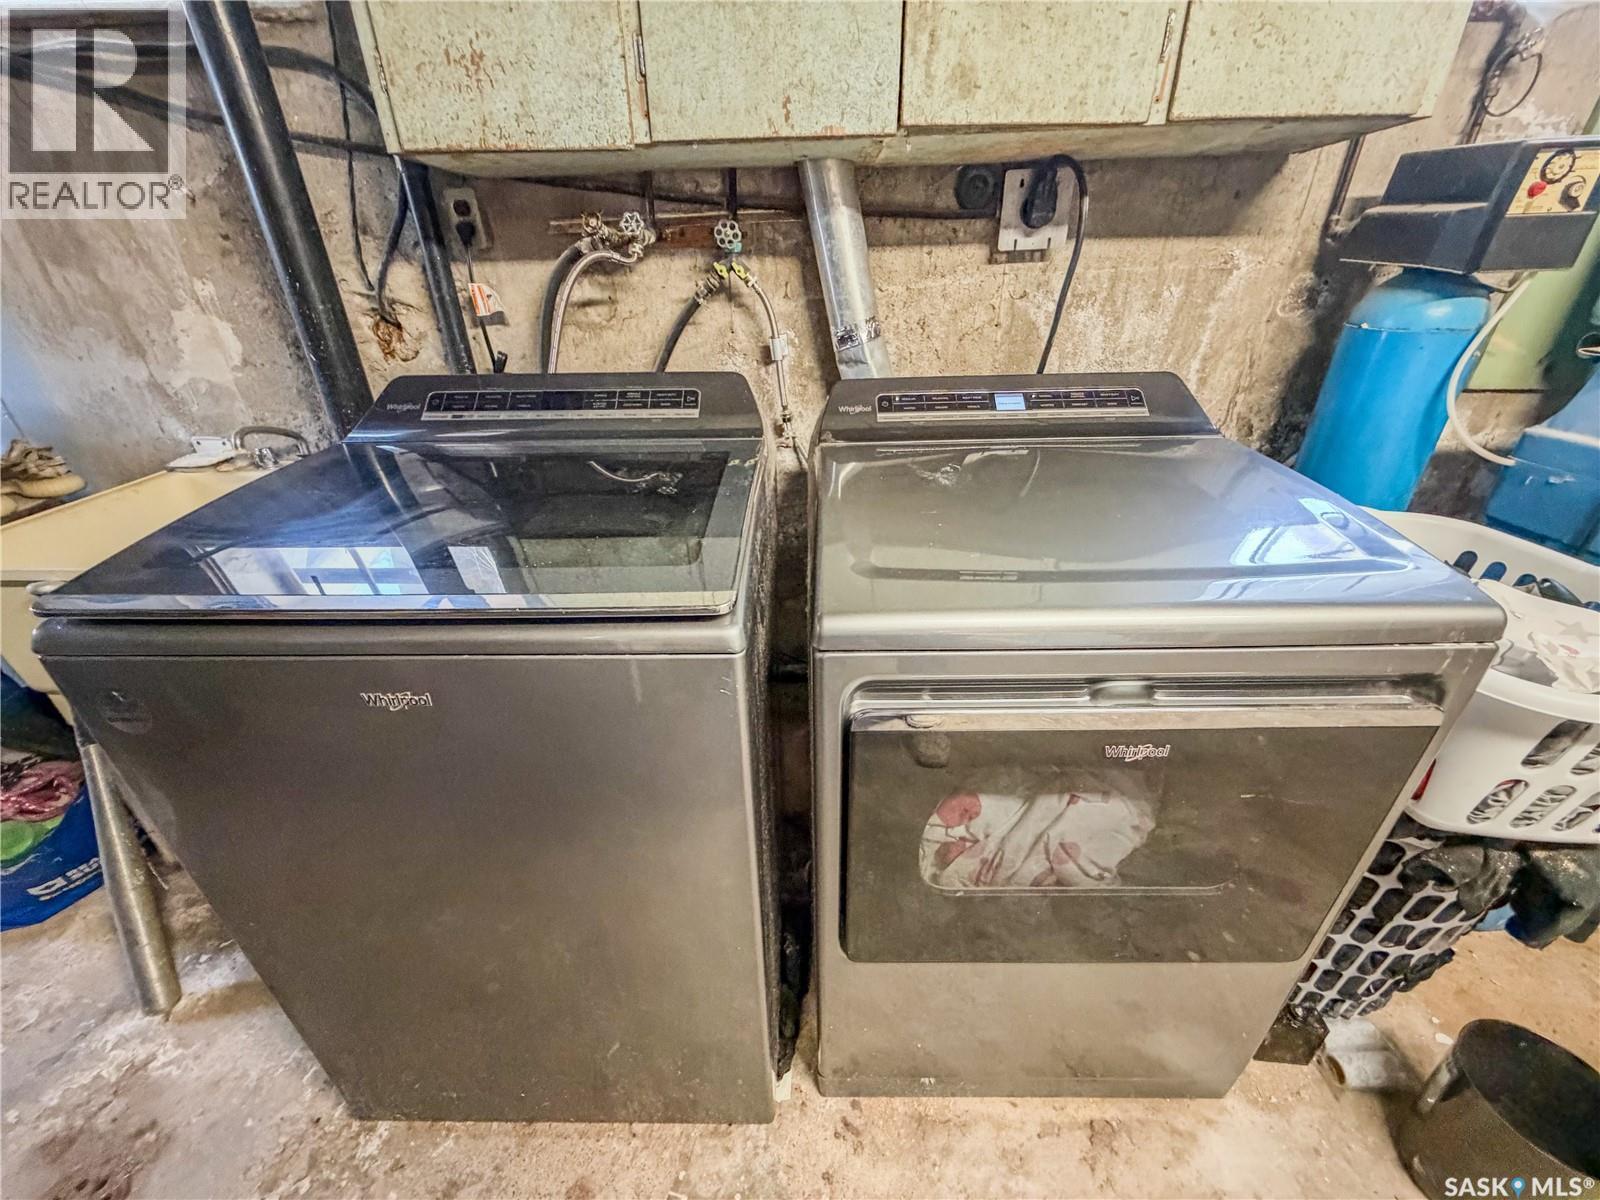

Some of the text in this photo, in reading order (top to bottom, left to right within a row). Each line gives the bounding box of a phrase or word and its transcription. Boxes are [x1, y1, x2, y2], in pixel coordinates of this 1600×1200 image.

[838, 404, 872, 415] Whirlpool
[360, 691, 433, 711] Whirlpool
[1104, 743, 1172, 762] Whirlpool
